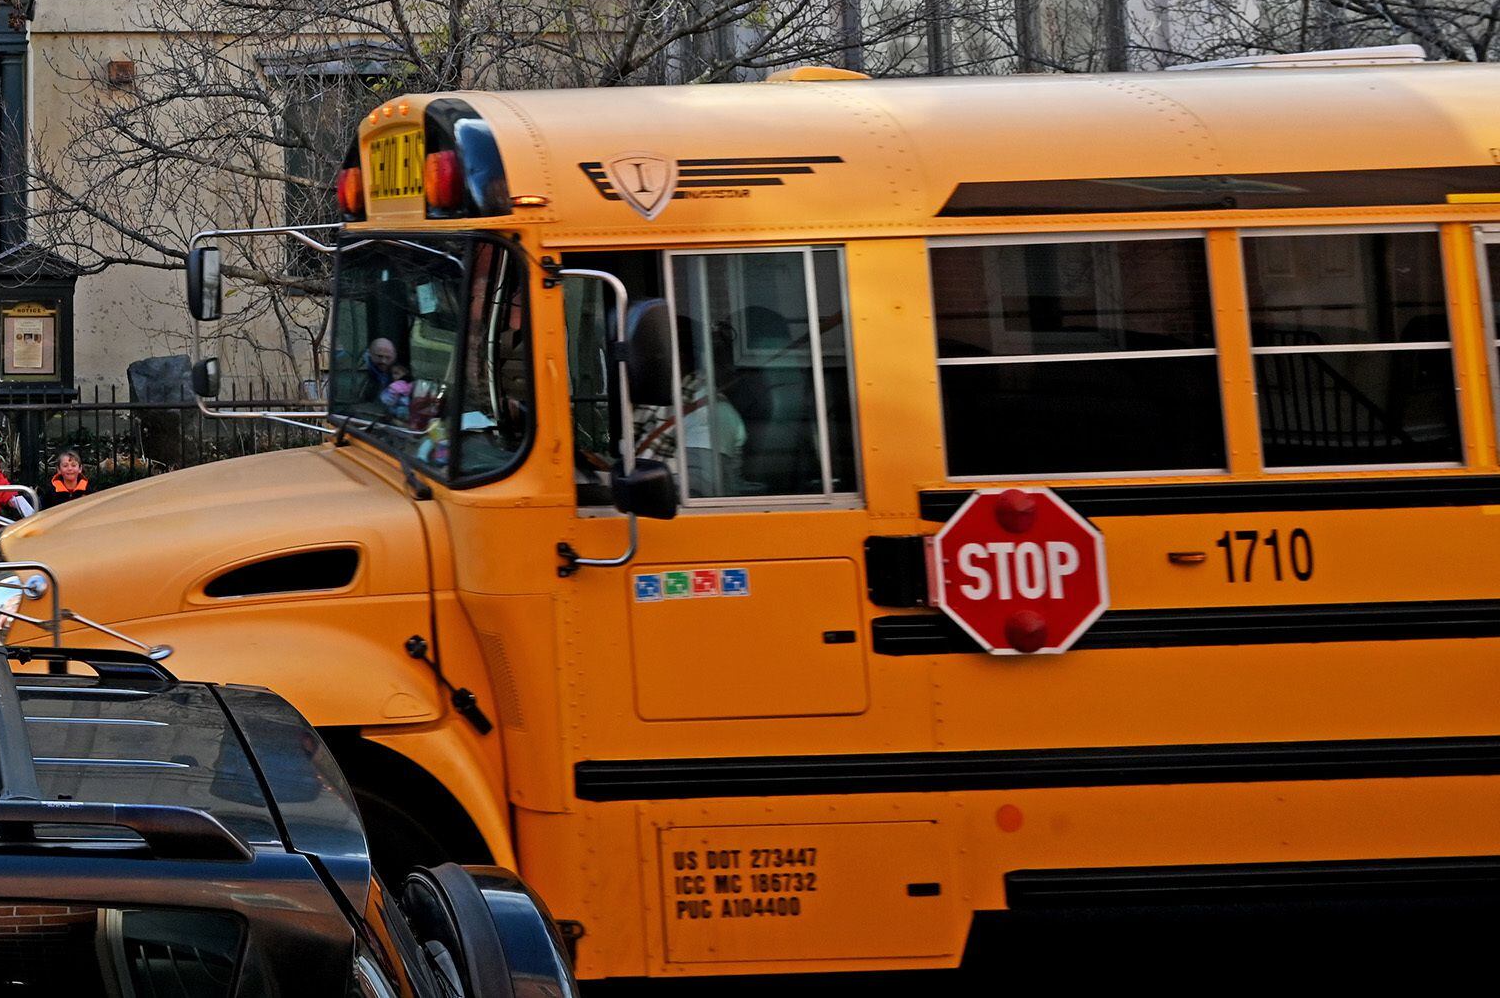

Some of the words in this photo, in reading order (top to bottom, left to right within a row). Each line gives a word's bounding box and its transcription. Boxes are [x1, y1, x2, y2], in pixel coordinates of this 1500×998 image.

[1216, 527, 1315, 583] 1710
[957, 541, 1080, 601] STOP
[673, 851, 698, 871] US
[706, 849, 742, 870] DOT
[750, 847, 817, 869] 273447
[675, 875, 706, 895] ICC
[714, 874, 742, 894] MC
[751, 872, 818, 893] 186732
[676, 899, 713, 920] PUC
[721, 897, 802, 919] A104400
